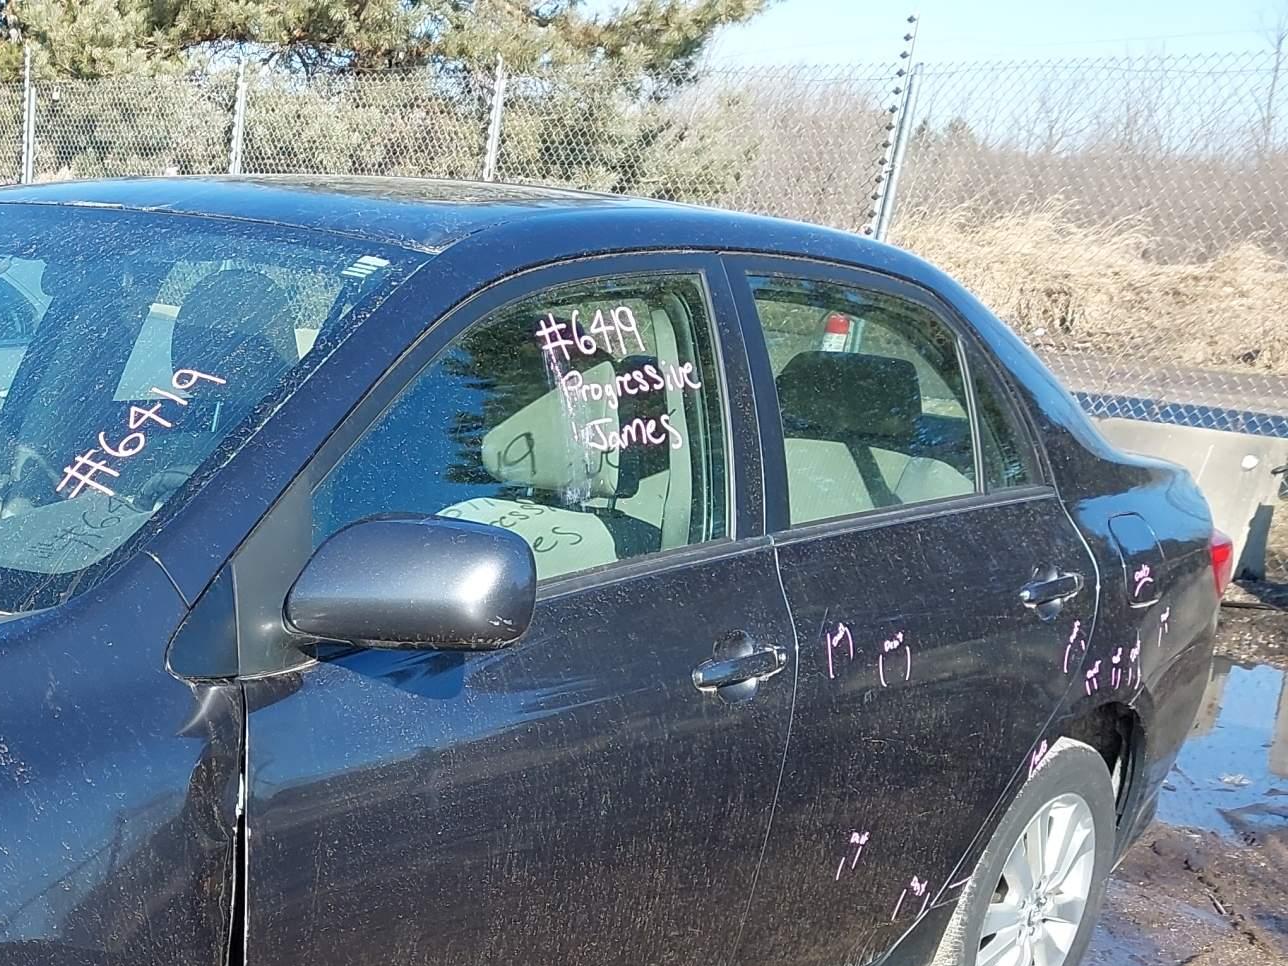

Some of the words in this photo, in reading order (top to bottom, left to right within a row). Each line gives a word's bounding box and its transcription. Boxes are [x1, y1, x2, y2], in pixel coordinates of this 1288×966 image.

[536, 306, 646, 361] #6419
[560, 360, 701, 410] Progressive
[55, 369, 227, 499] #6419
[585, 414, 683, 449] James
